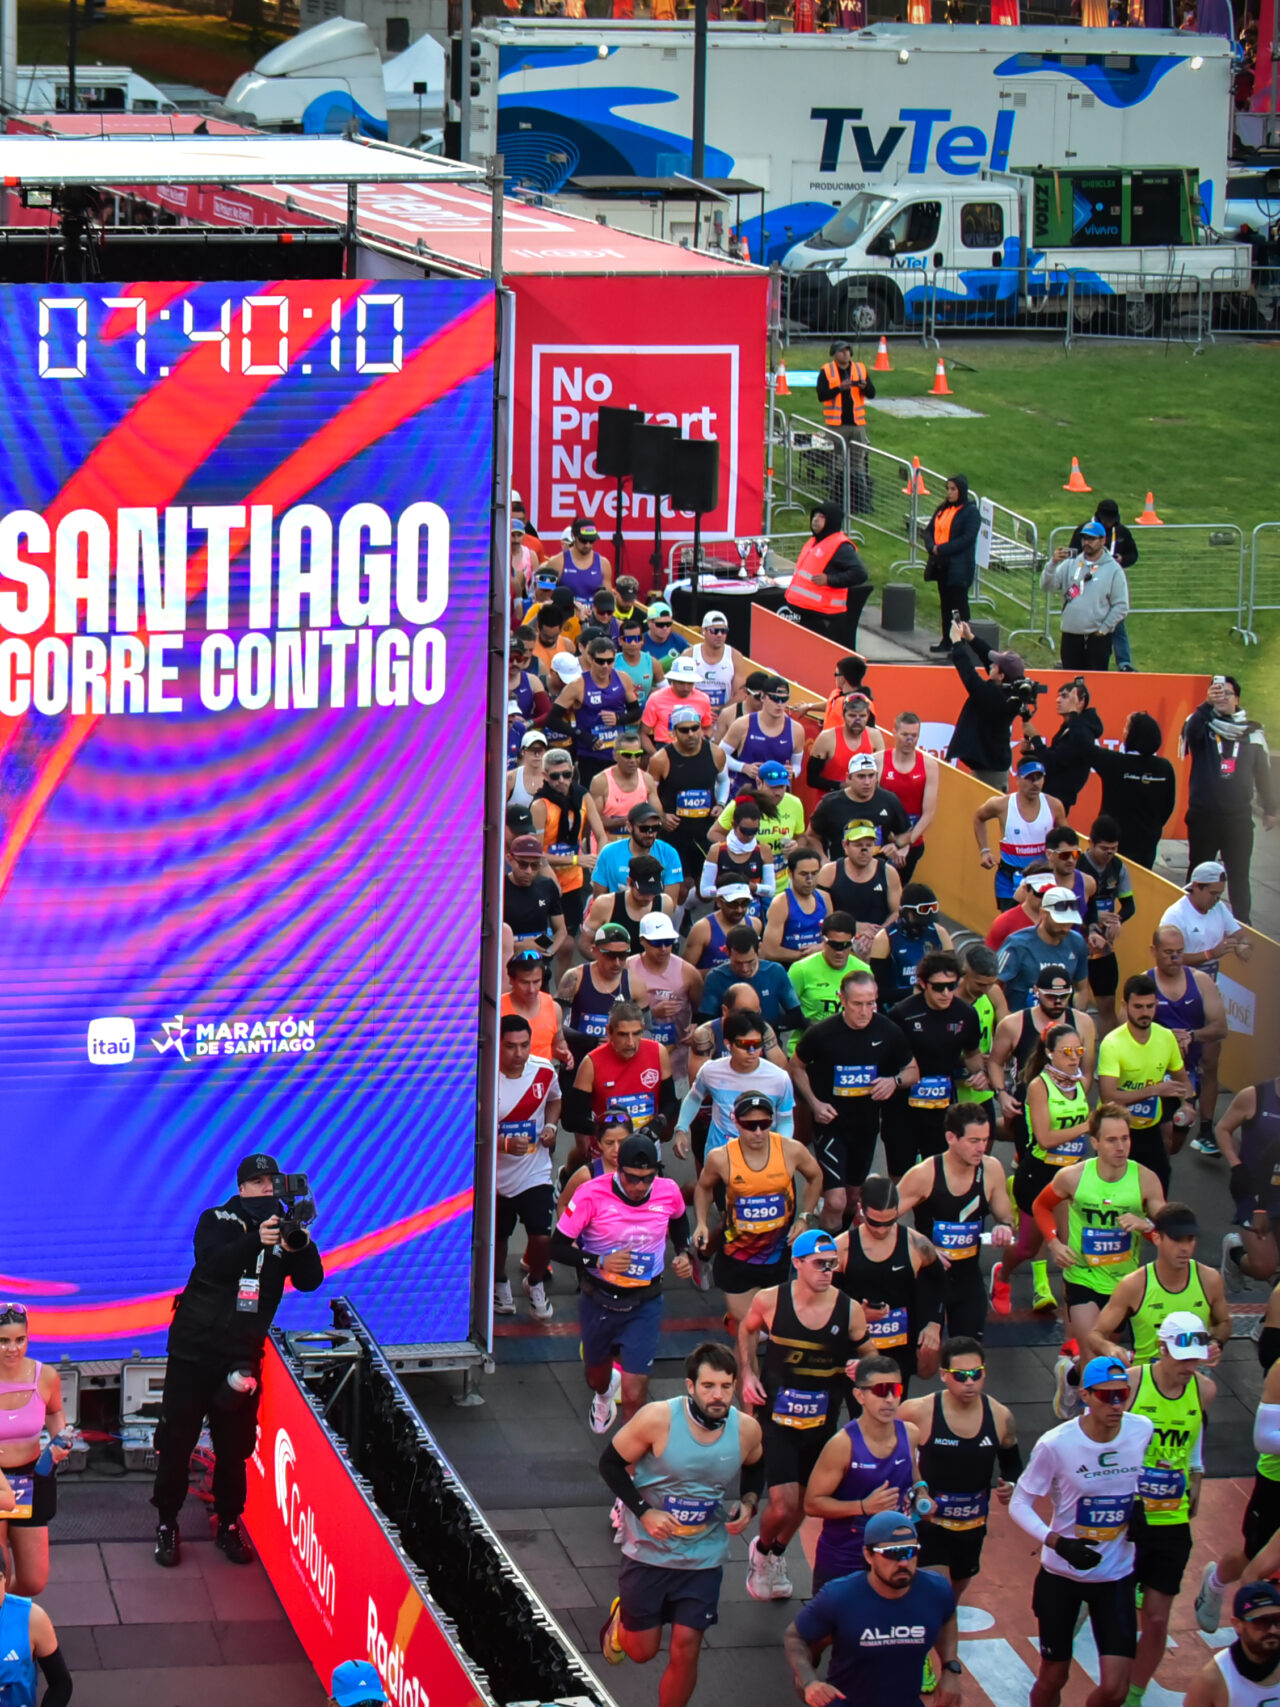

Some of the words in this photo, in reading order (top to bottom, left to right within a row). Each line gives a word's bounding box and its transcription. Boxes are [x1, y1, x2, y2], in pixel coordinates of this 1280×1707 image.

[810, 107, 1016, 175] TvTel
[1035, 183, 1050, 237] VOLTZ
[38, 294, 404, 378] 07:40:10
[552, 366, 613, 402] No
[199, 627, 447, 711] CONTIGO
[683, 798, 706, 808] 1407
[195, 1016, 315, 1041] MARATÓN
[92, 1038, 130, 1055] itaú
[195, 1042, 219, 1056] DE
[224, 1038, 316, 1054] SANTIAGO
[839, 1074, 872, 1085] 3243
[743, 1206, 777, 1218] 6290
[941, 1234, 973, 1246] 3786
[1093, 1240, 1122, 1252] 3113
[787, 1402, 819, 1415] 1913
[1083, 1465, 1138, 1479] CRONOS
[1140, 1481, 1177, 1495] 2554
[943, 1504, 980, 1517] 5854
[1088, 1509, 1125, 1523] 1738
[290, 1482, 336, 1617] Colbun
